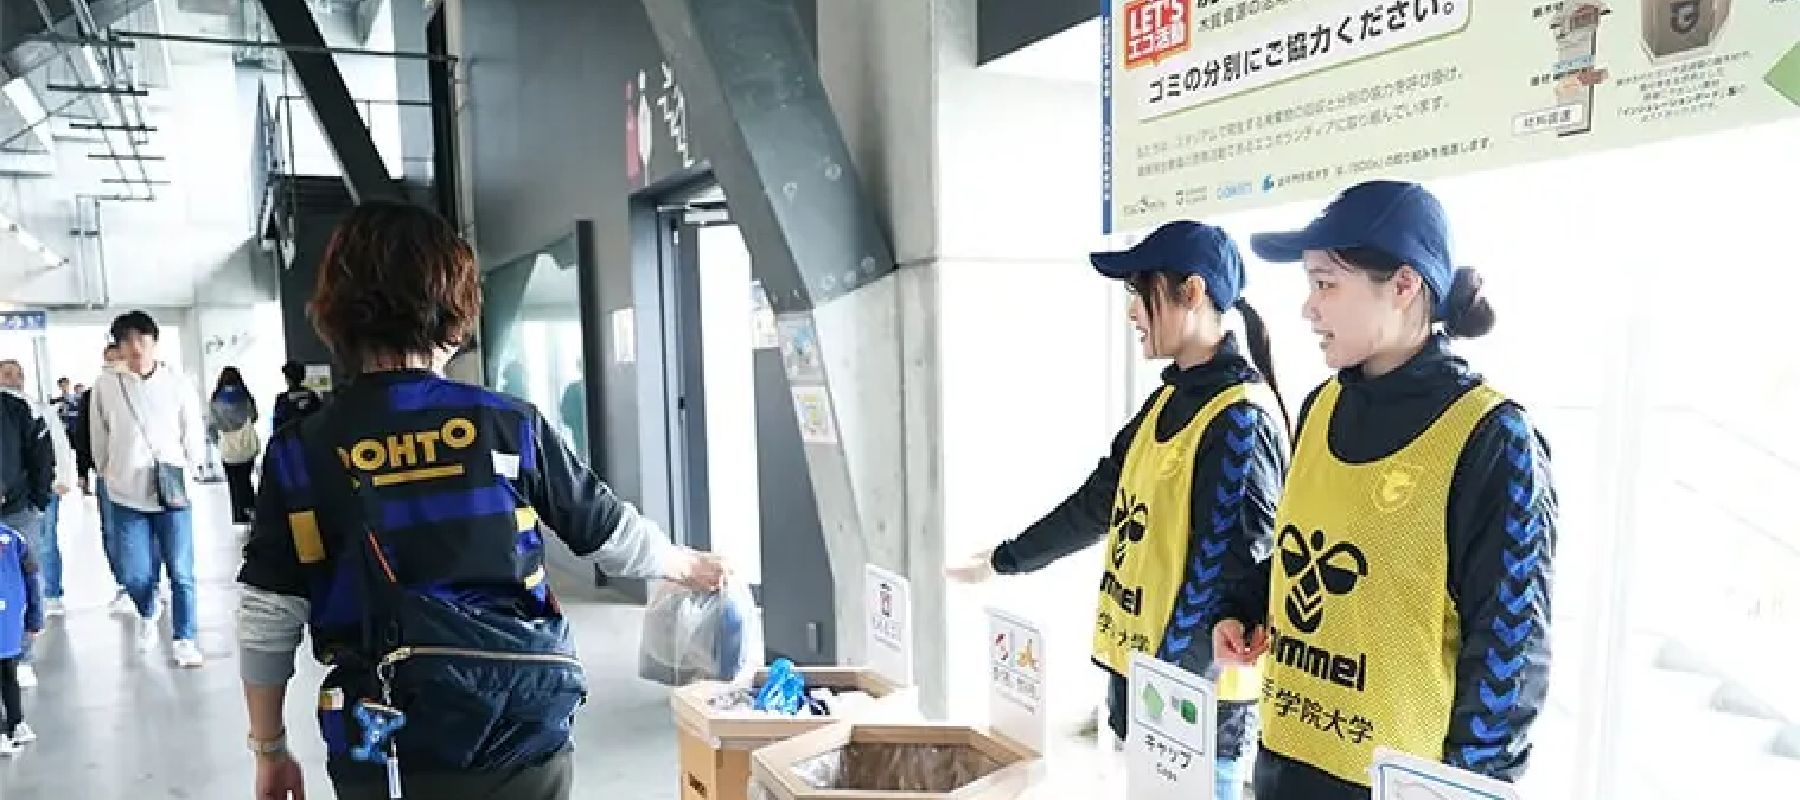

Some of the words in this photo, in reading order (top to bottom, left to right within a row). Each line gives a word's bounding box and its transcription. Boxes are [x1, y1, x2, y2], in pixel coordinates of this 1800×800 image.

[1149, 0, 1455, 103] ゴミの分別にご協力ください。
